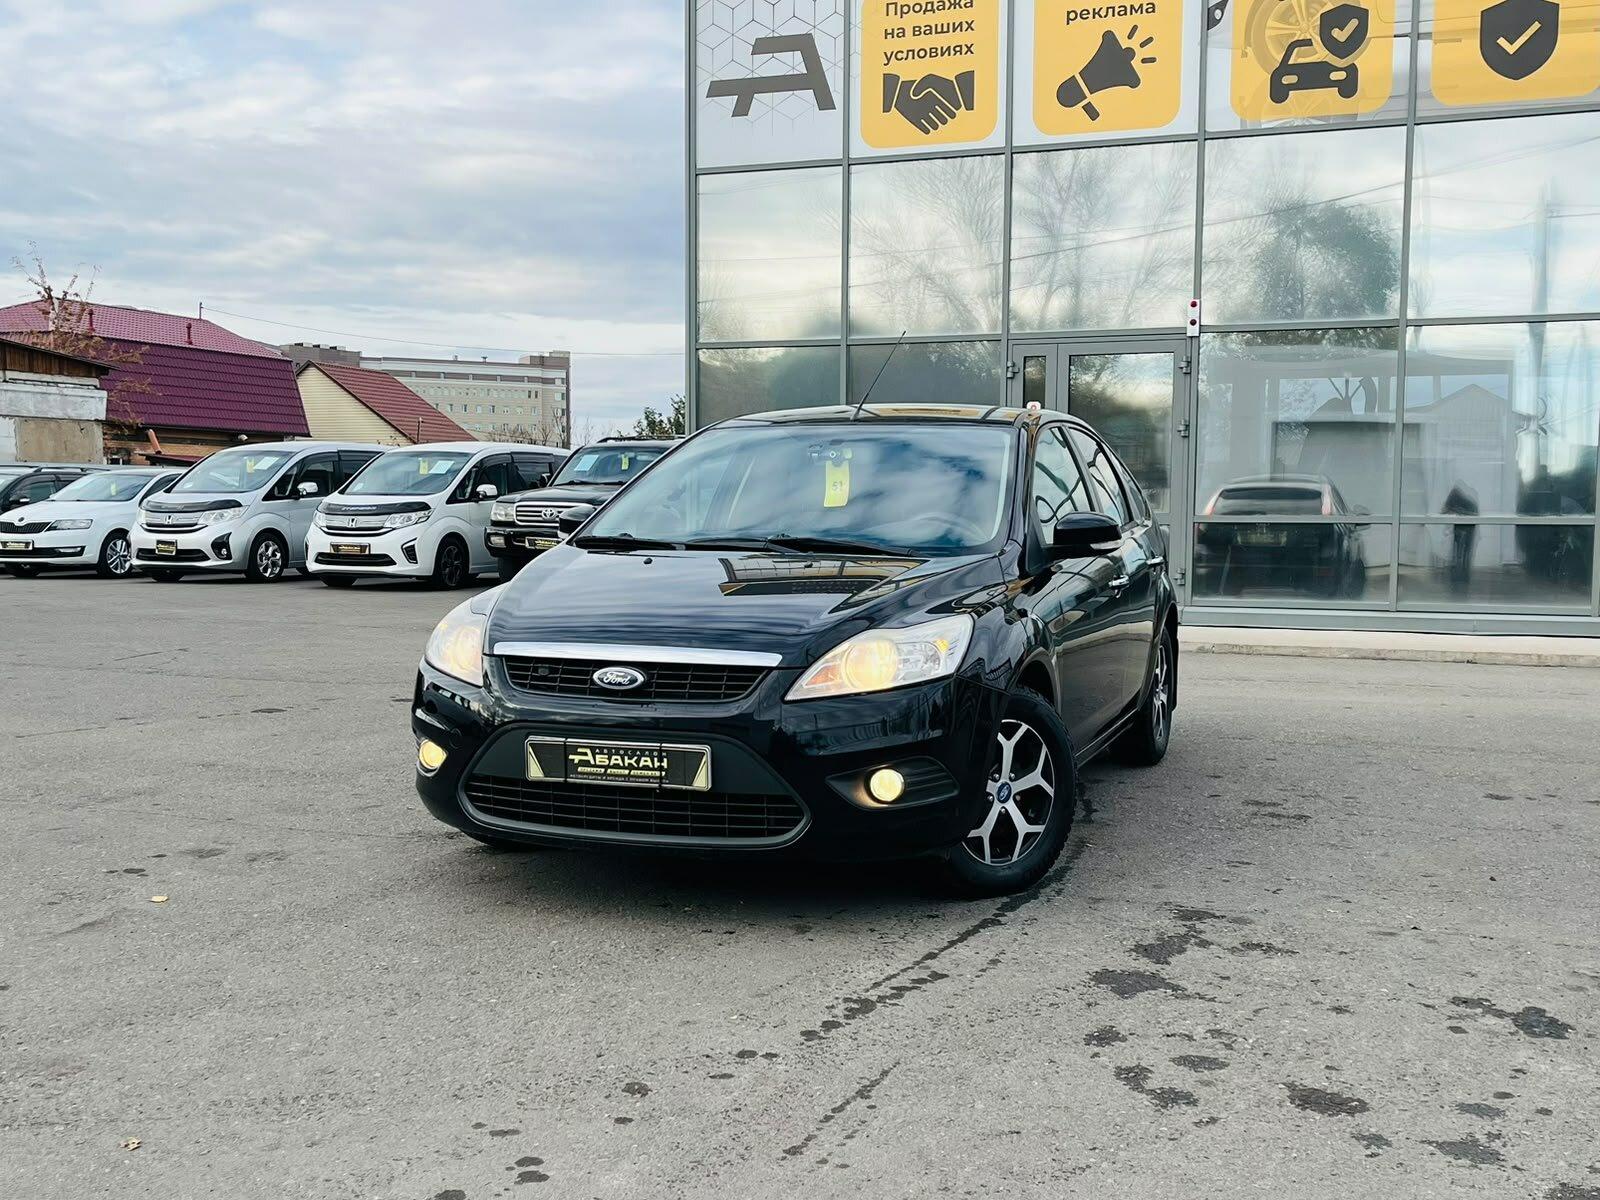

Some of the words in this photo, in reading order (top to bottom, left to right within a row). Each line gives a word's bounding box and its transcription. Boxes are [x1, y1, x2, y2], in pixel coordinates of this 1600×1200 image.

[885, 0, 974, 19] Продажа
[1066, 2, 1156, 25] реклама
[884, 26, 906, 39] на
[912, 20, 975, 36] ваших
[883, 43, 975, 66] условиях
[603, 671, 631, 685] Ford
